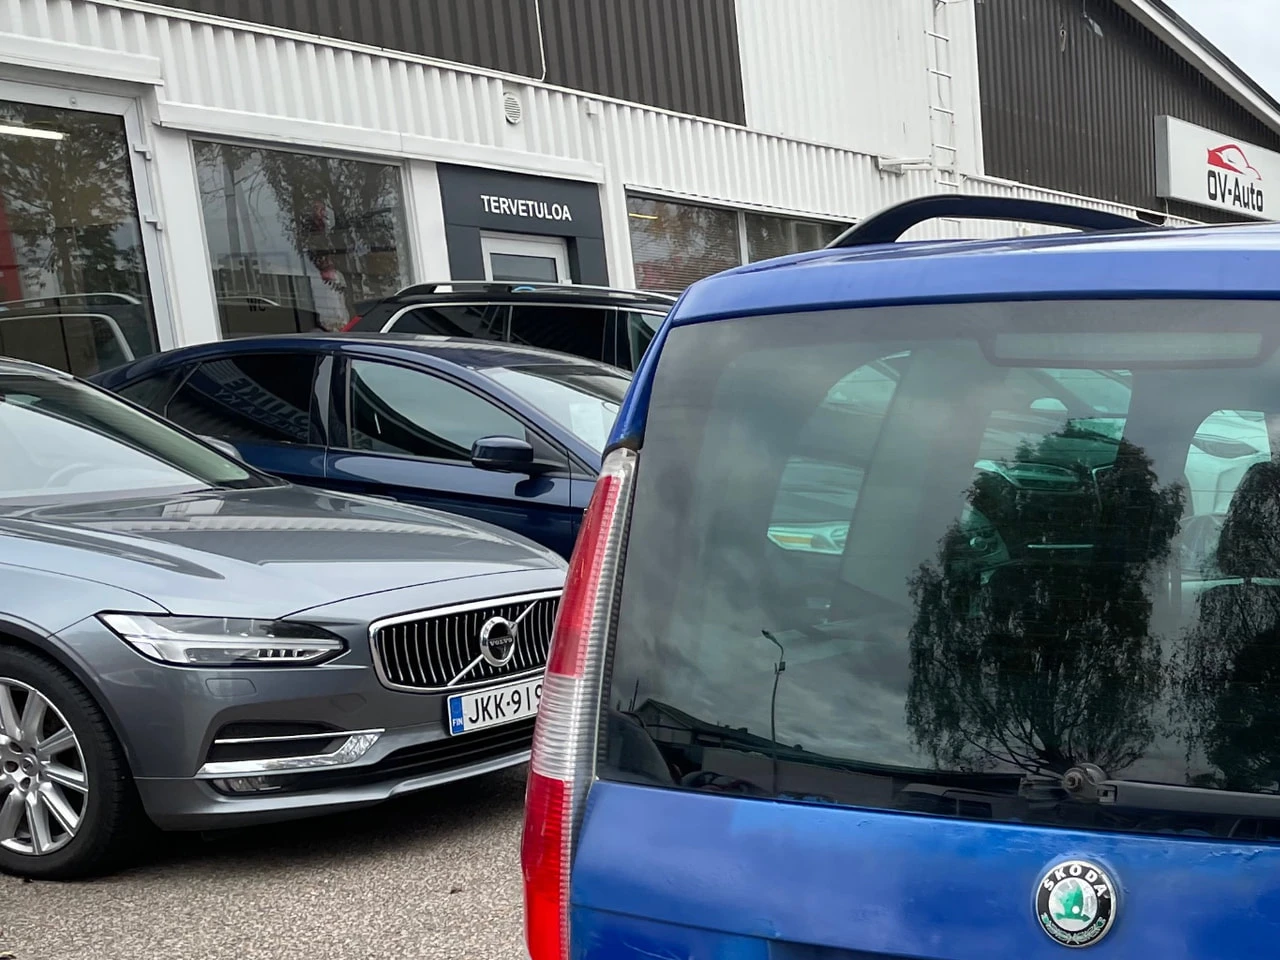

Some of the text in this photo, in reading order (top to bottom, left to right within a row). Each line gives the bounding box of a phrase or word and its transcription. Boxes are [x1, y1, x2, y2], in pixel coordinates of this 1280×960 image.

[1208, 169, 1264, 212] OV-Auto
[480, 194, 573, 221] TERVETULOA
[489, 637, 513, 647] VOLVO
